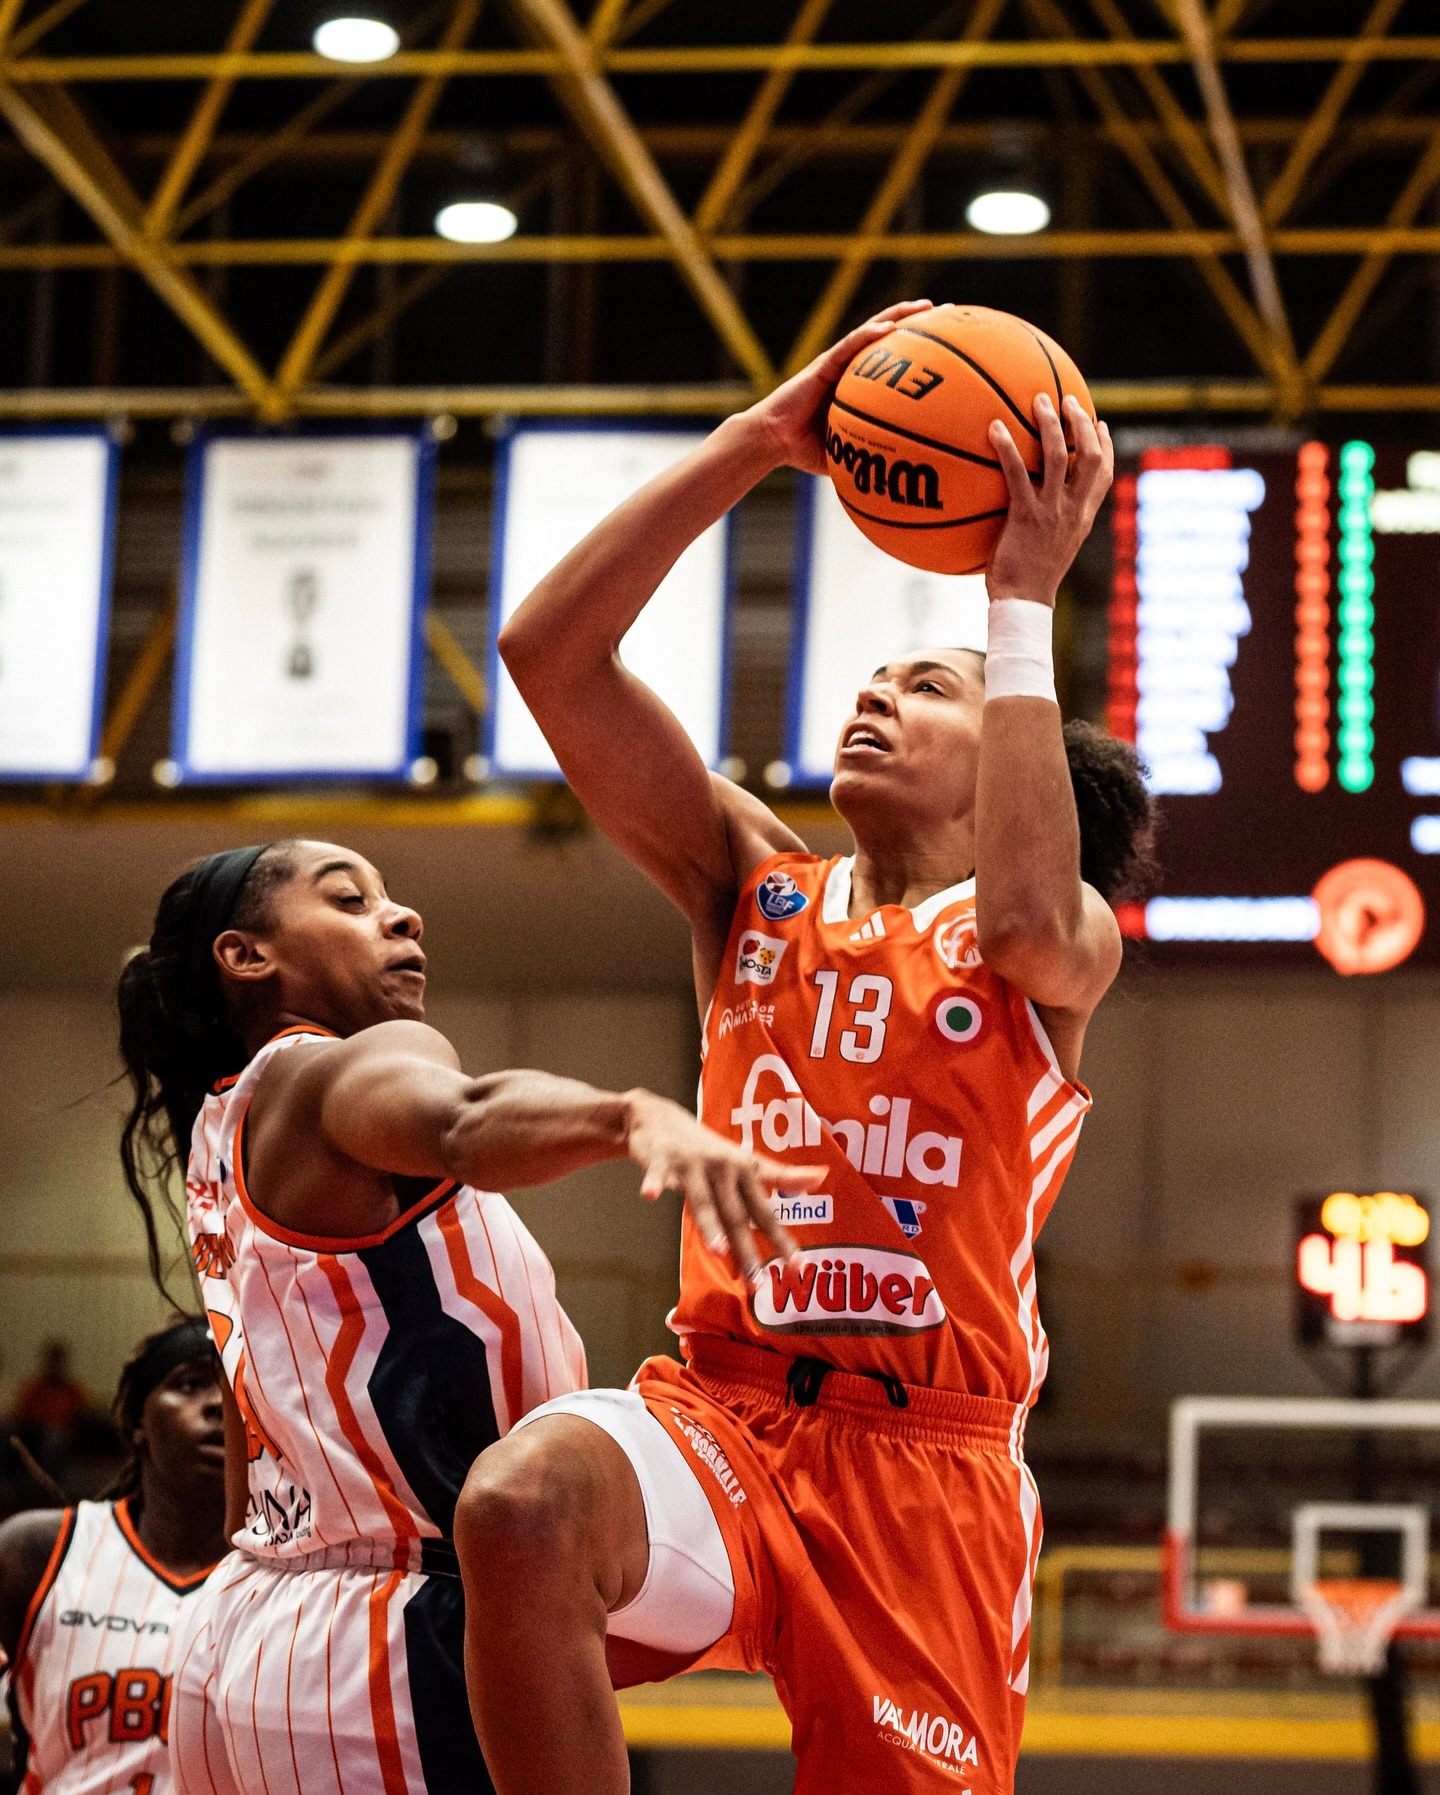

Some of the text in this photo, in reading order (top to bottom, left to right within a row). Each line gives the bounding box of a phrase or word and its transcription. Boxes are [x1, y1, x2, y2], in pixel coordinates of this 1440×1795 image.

[809, 969, 893, 1064] 13
[731, 1053, 963, 1188] famila
[769, 1258, 935, 1316] Wüber
[873, 1695, 979, 1767] VALMORA
[877, 1730, 916, 1752] ACQUA
